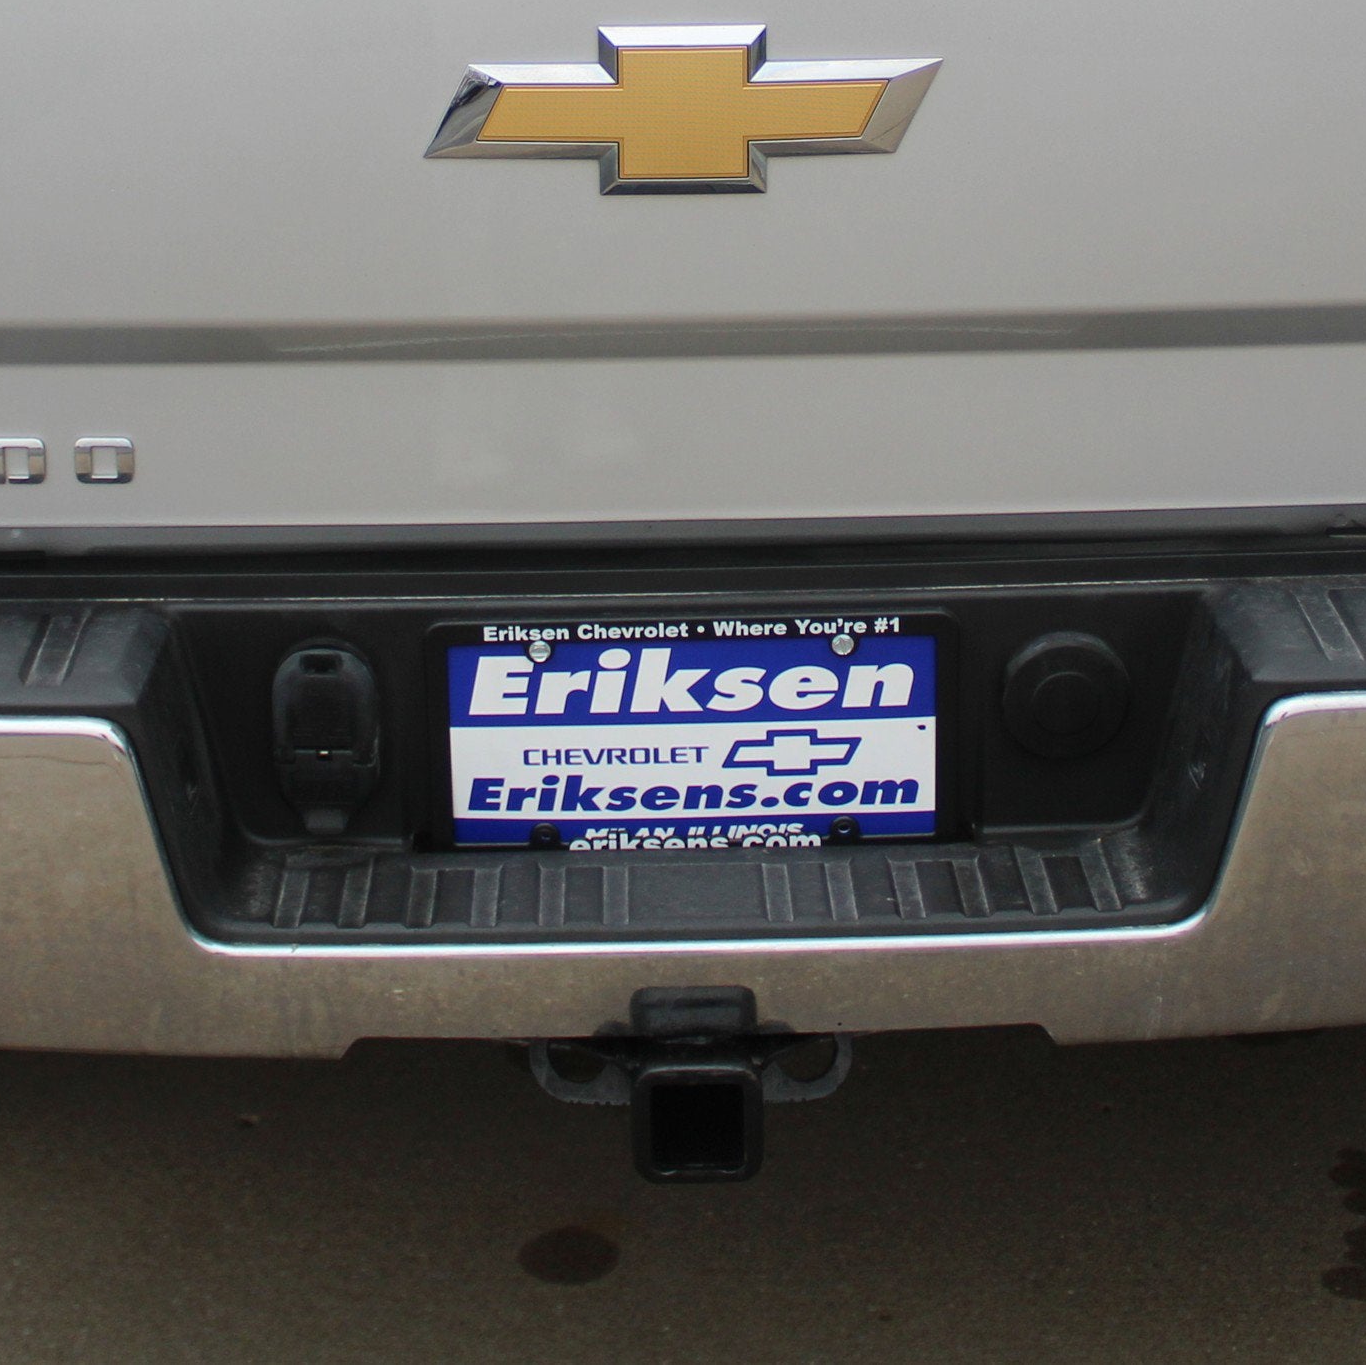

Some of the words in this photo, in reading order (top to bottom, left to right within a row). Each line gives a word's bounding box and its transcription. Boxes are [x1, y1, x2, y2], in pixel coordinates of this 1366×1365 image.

[483, 626, 570, 642] Eriksen
[577, 622, 689, 640] Chevrolet
[713, 621, 787, 636] Where
[795, 618, 867, 635] You're
[874, 617, 900, 633] #1
[468, 647, 915, 716] Eriksen
[522, 746, 709, 766] CHEVROLET
[467, 774, 920, 813] Eriksens.com
